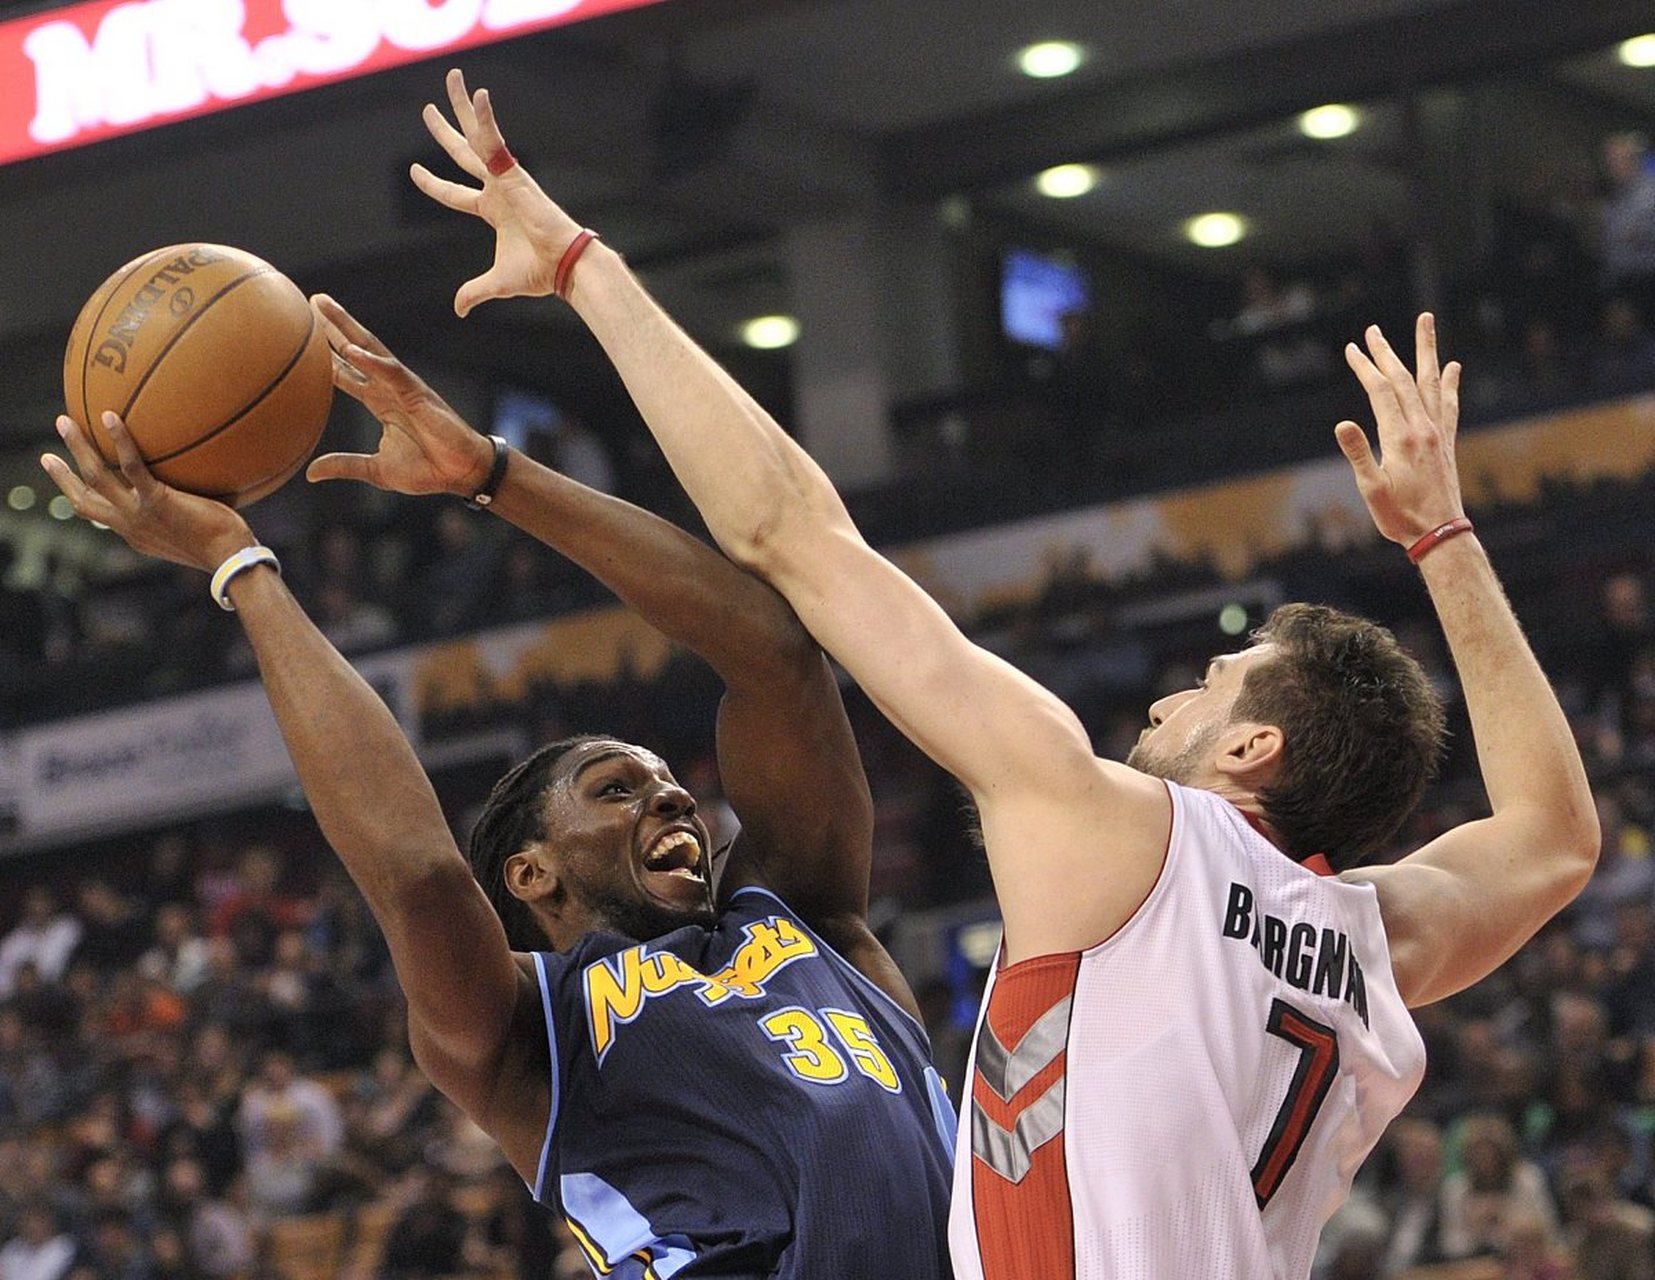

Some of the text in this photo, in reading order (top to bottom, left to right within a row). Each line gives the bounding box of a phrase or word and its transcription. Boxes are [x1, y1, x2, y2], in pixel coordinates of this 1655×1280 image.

[1222, 882, 1370, 1032] BARGNA
[757, 1005, 903, 1094] 35
[1250, 997, 1340, 1212] 7
